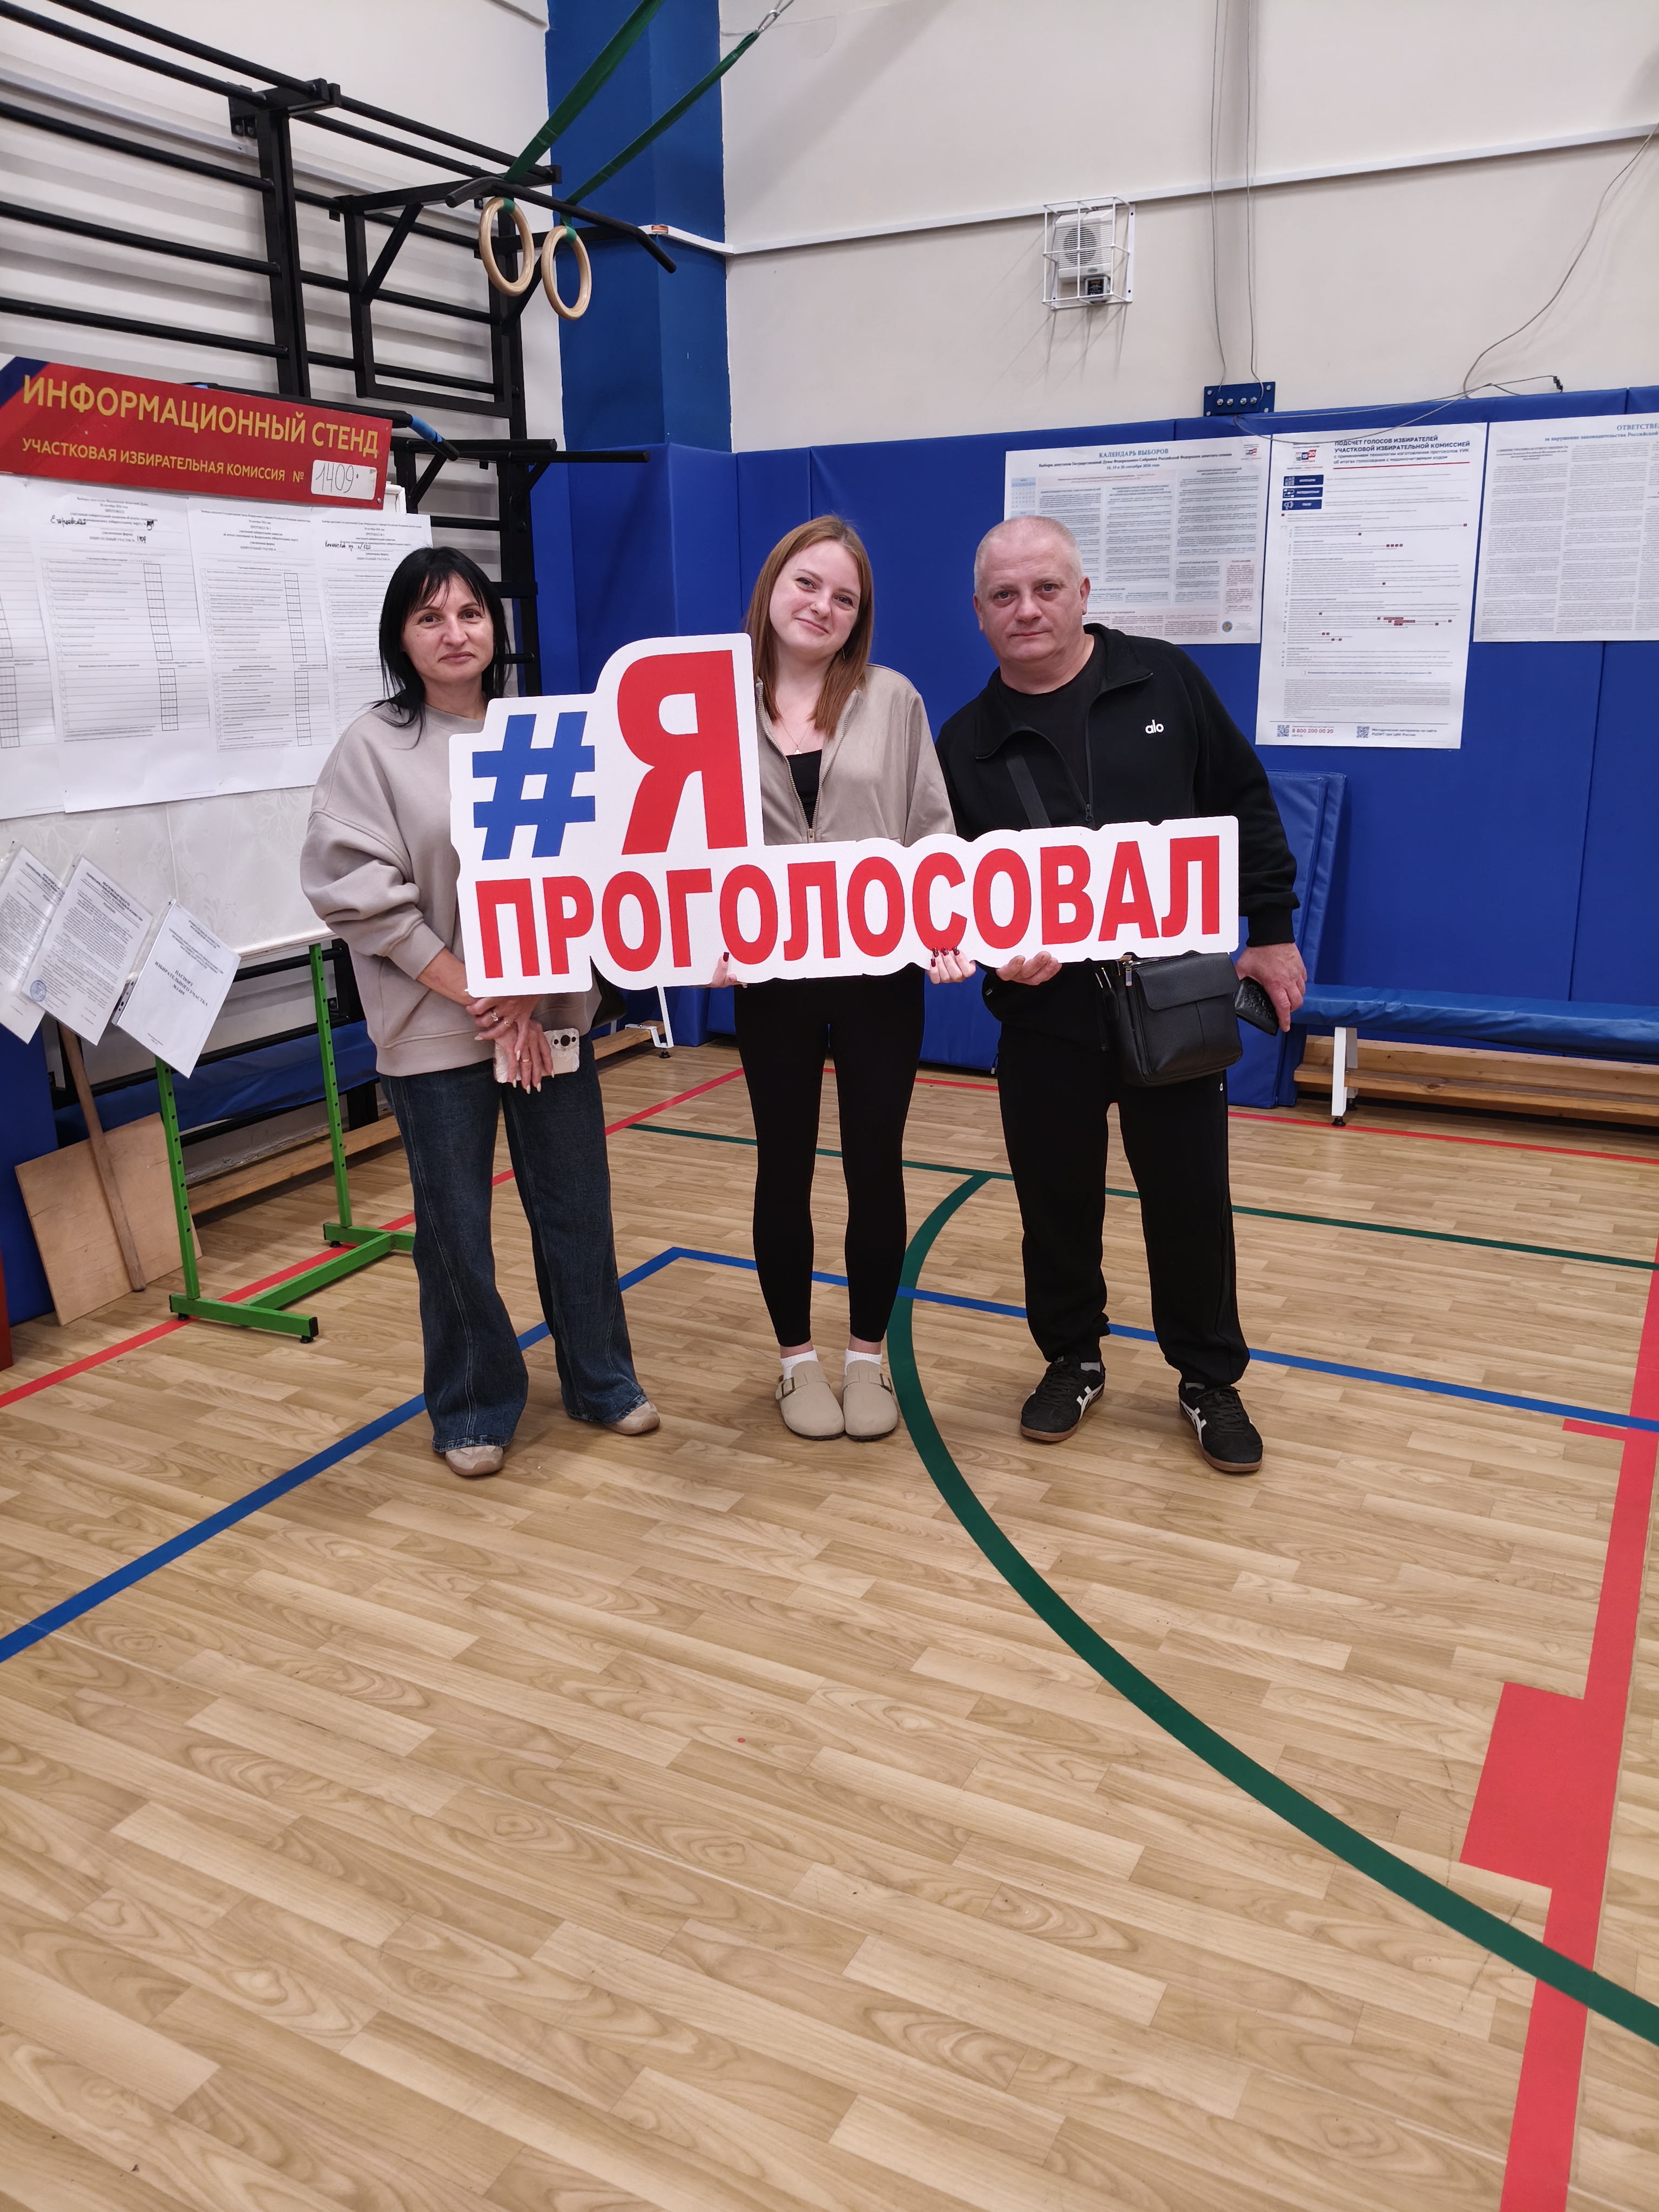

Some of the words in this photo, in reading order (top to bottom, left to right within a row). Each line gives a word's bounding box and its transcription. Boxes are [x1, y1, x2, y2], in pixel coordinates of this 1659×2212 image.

[23, 375, 306, 441] ИНФОРМАЦИОННЫЙ
[312, 421, 379, 458] СТЕНД
[23, 437, 117, 462] УЧАСТКОВАЯ
[120, 450, 225, 474] ИЗБИРАТЕЛЬНАЯ
[227, 462, 285, 482] КОМИССИЯ
[293, 471, 305, 482] №
[1099, 450, 1136, 458] КАЛЕНДАРЬ
[1377, 443, 1429, 451] ИЗБИРАТЕЛЬНОЙ
[315, 462, 354, 494] 1409
[1145, 719, 1164, 734] alo
[475, 835, 1220, 978] ПРОГОЛОСОВАЛ
